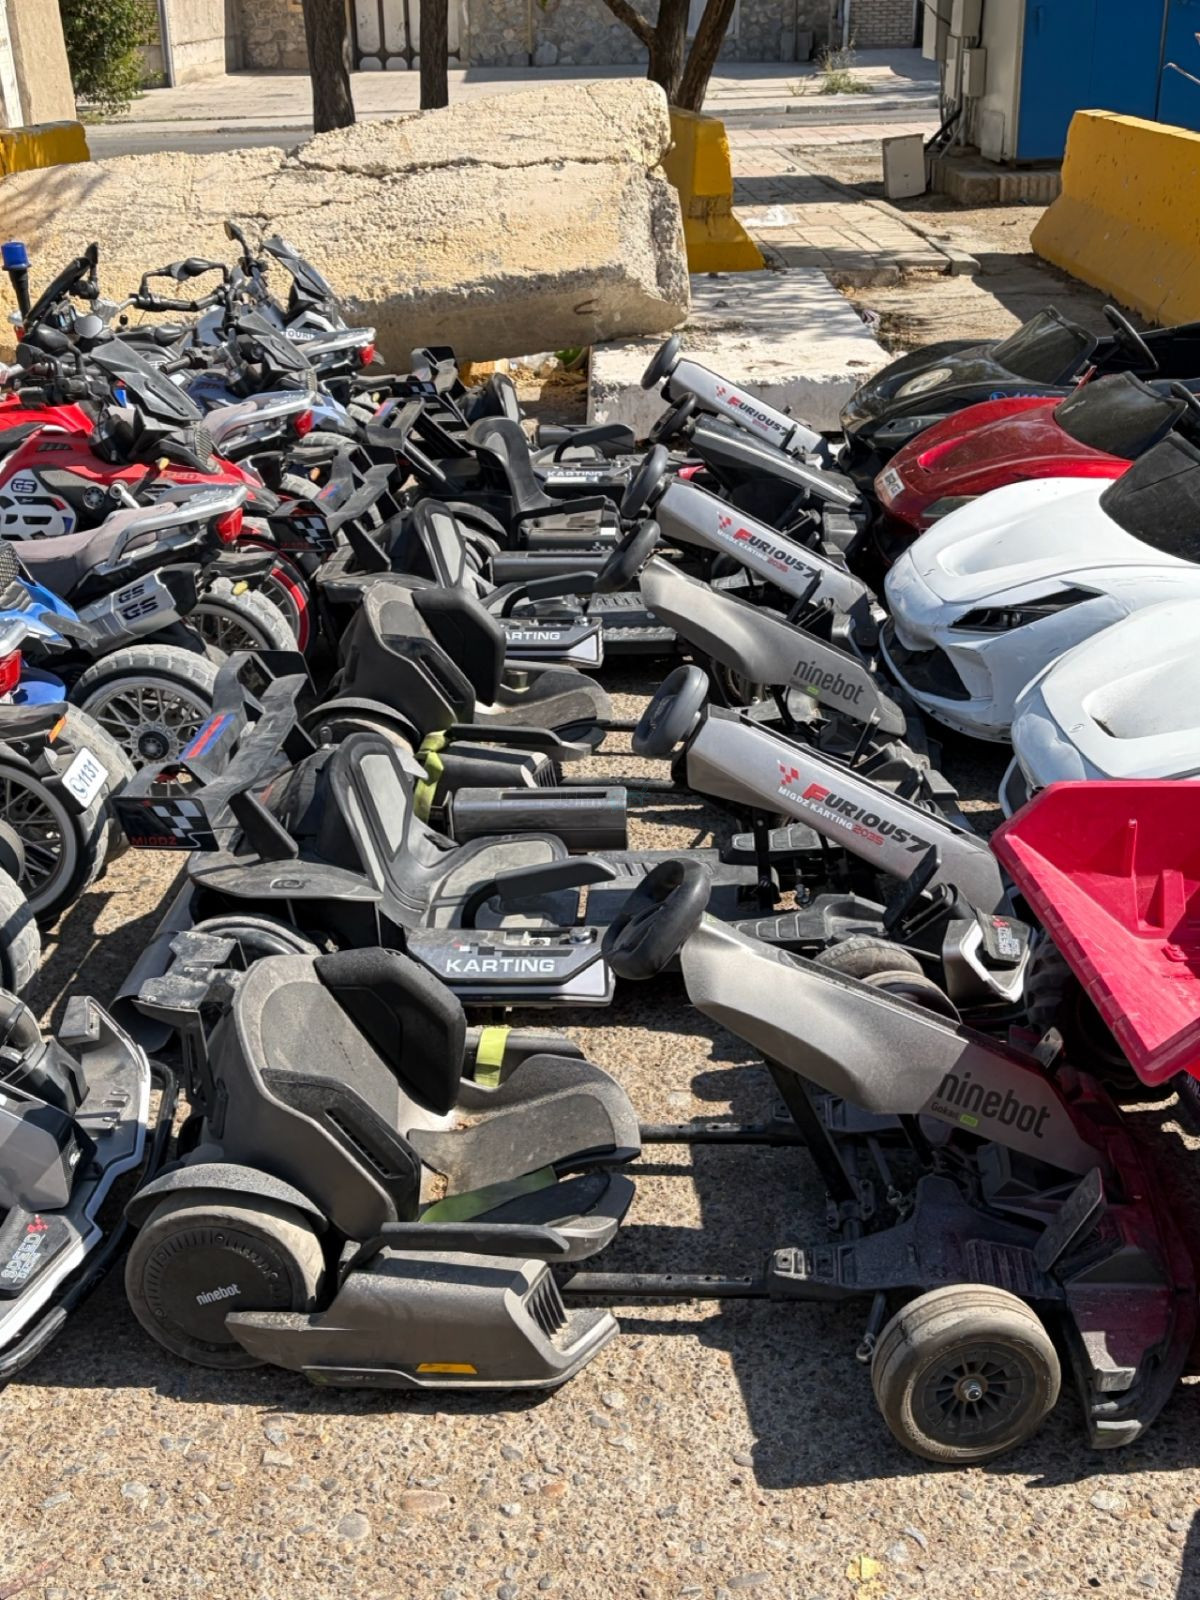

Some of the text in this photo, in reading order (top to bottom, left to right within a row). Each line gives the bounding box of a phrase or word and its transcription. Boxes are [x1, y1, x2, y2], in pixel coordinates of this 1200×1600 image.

[727, 396, 789, 437] FURIOUS7
[12, 480, 36, 493] GS
[733, 528, 819, 578] FURIOUS7
[118, 584, 146, 604] GS
[123, 595, 160, 620] GS
[793, 660, 865, 705] ninebot
[778, 786, 809, 808] MIGDZ
[810, 803, 853, 830] KARTING
[802, 783, 932, 853] FURIOUS7
[446, 959, 556, 973] KARTING
[937, 1072, 1051, 1138] ninebot
[196, 1283, 242, 1306] ninebot
